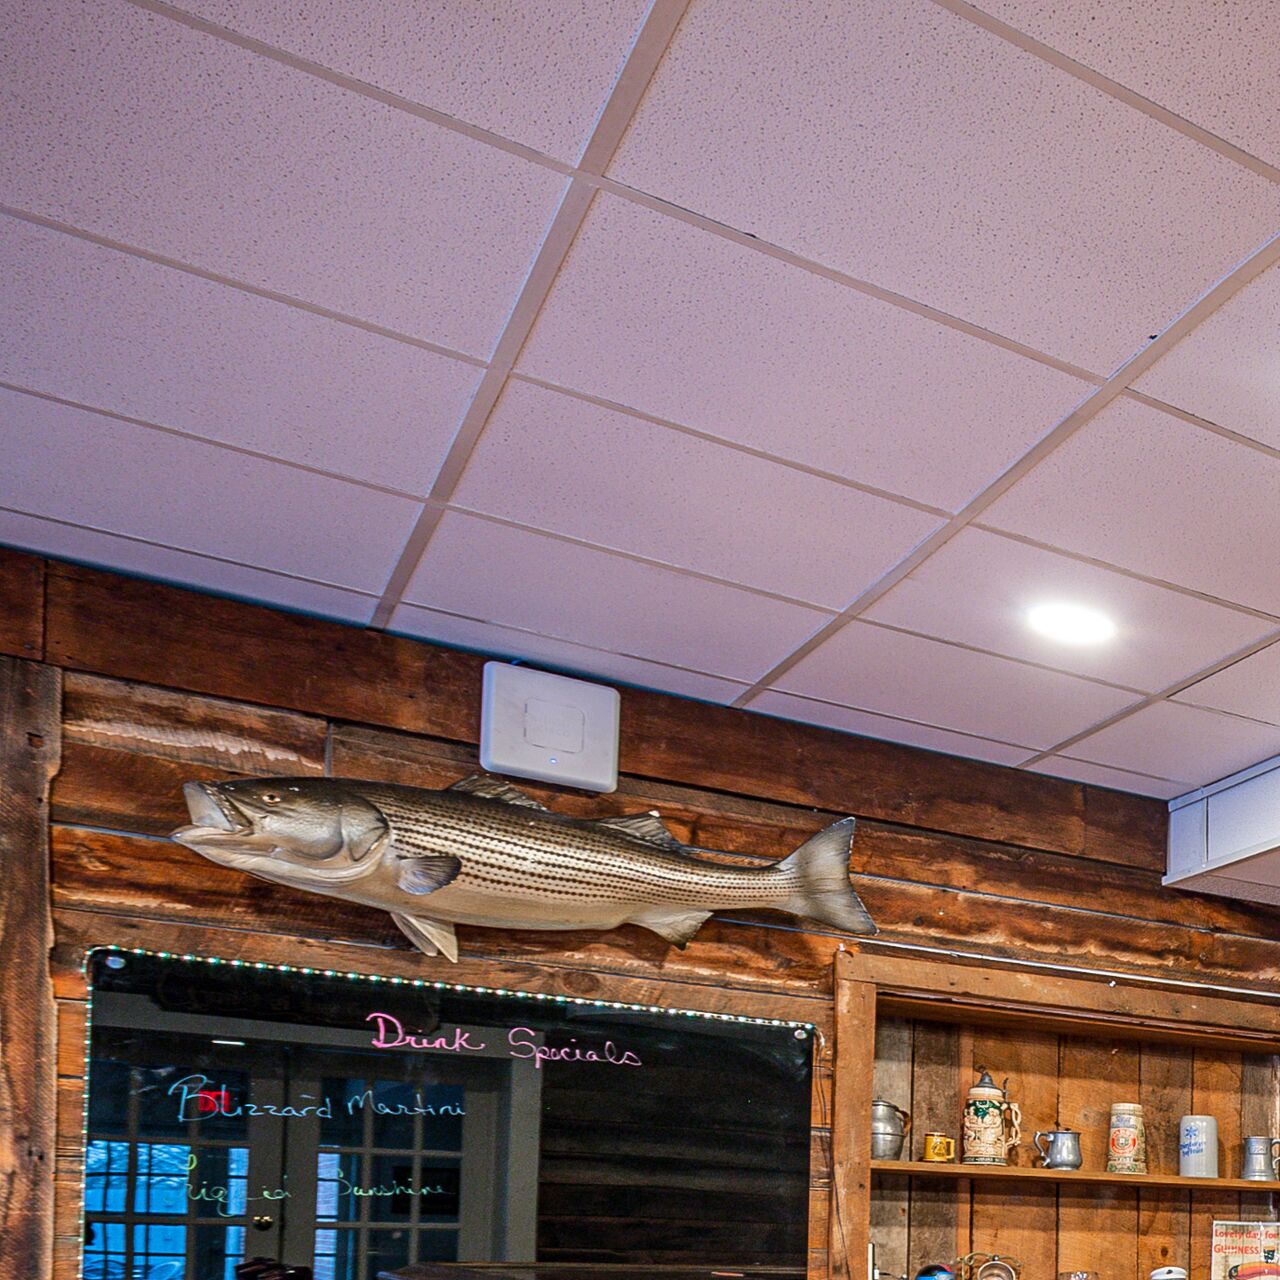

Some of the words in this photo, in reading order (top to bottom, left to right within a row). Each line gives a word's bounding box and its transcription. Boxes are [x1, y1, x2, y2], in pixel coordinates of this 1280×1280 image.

[366, 1012, 486, 1052] Drink
[508, 1027, 643, 1069] Specials
[167, 1074, 332, 1123] Blizzard
[347, 1091, 467, 1118] Martini
